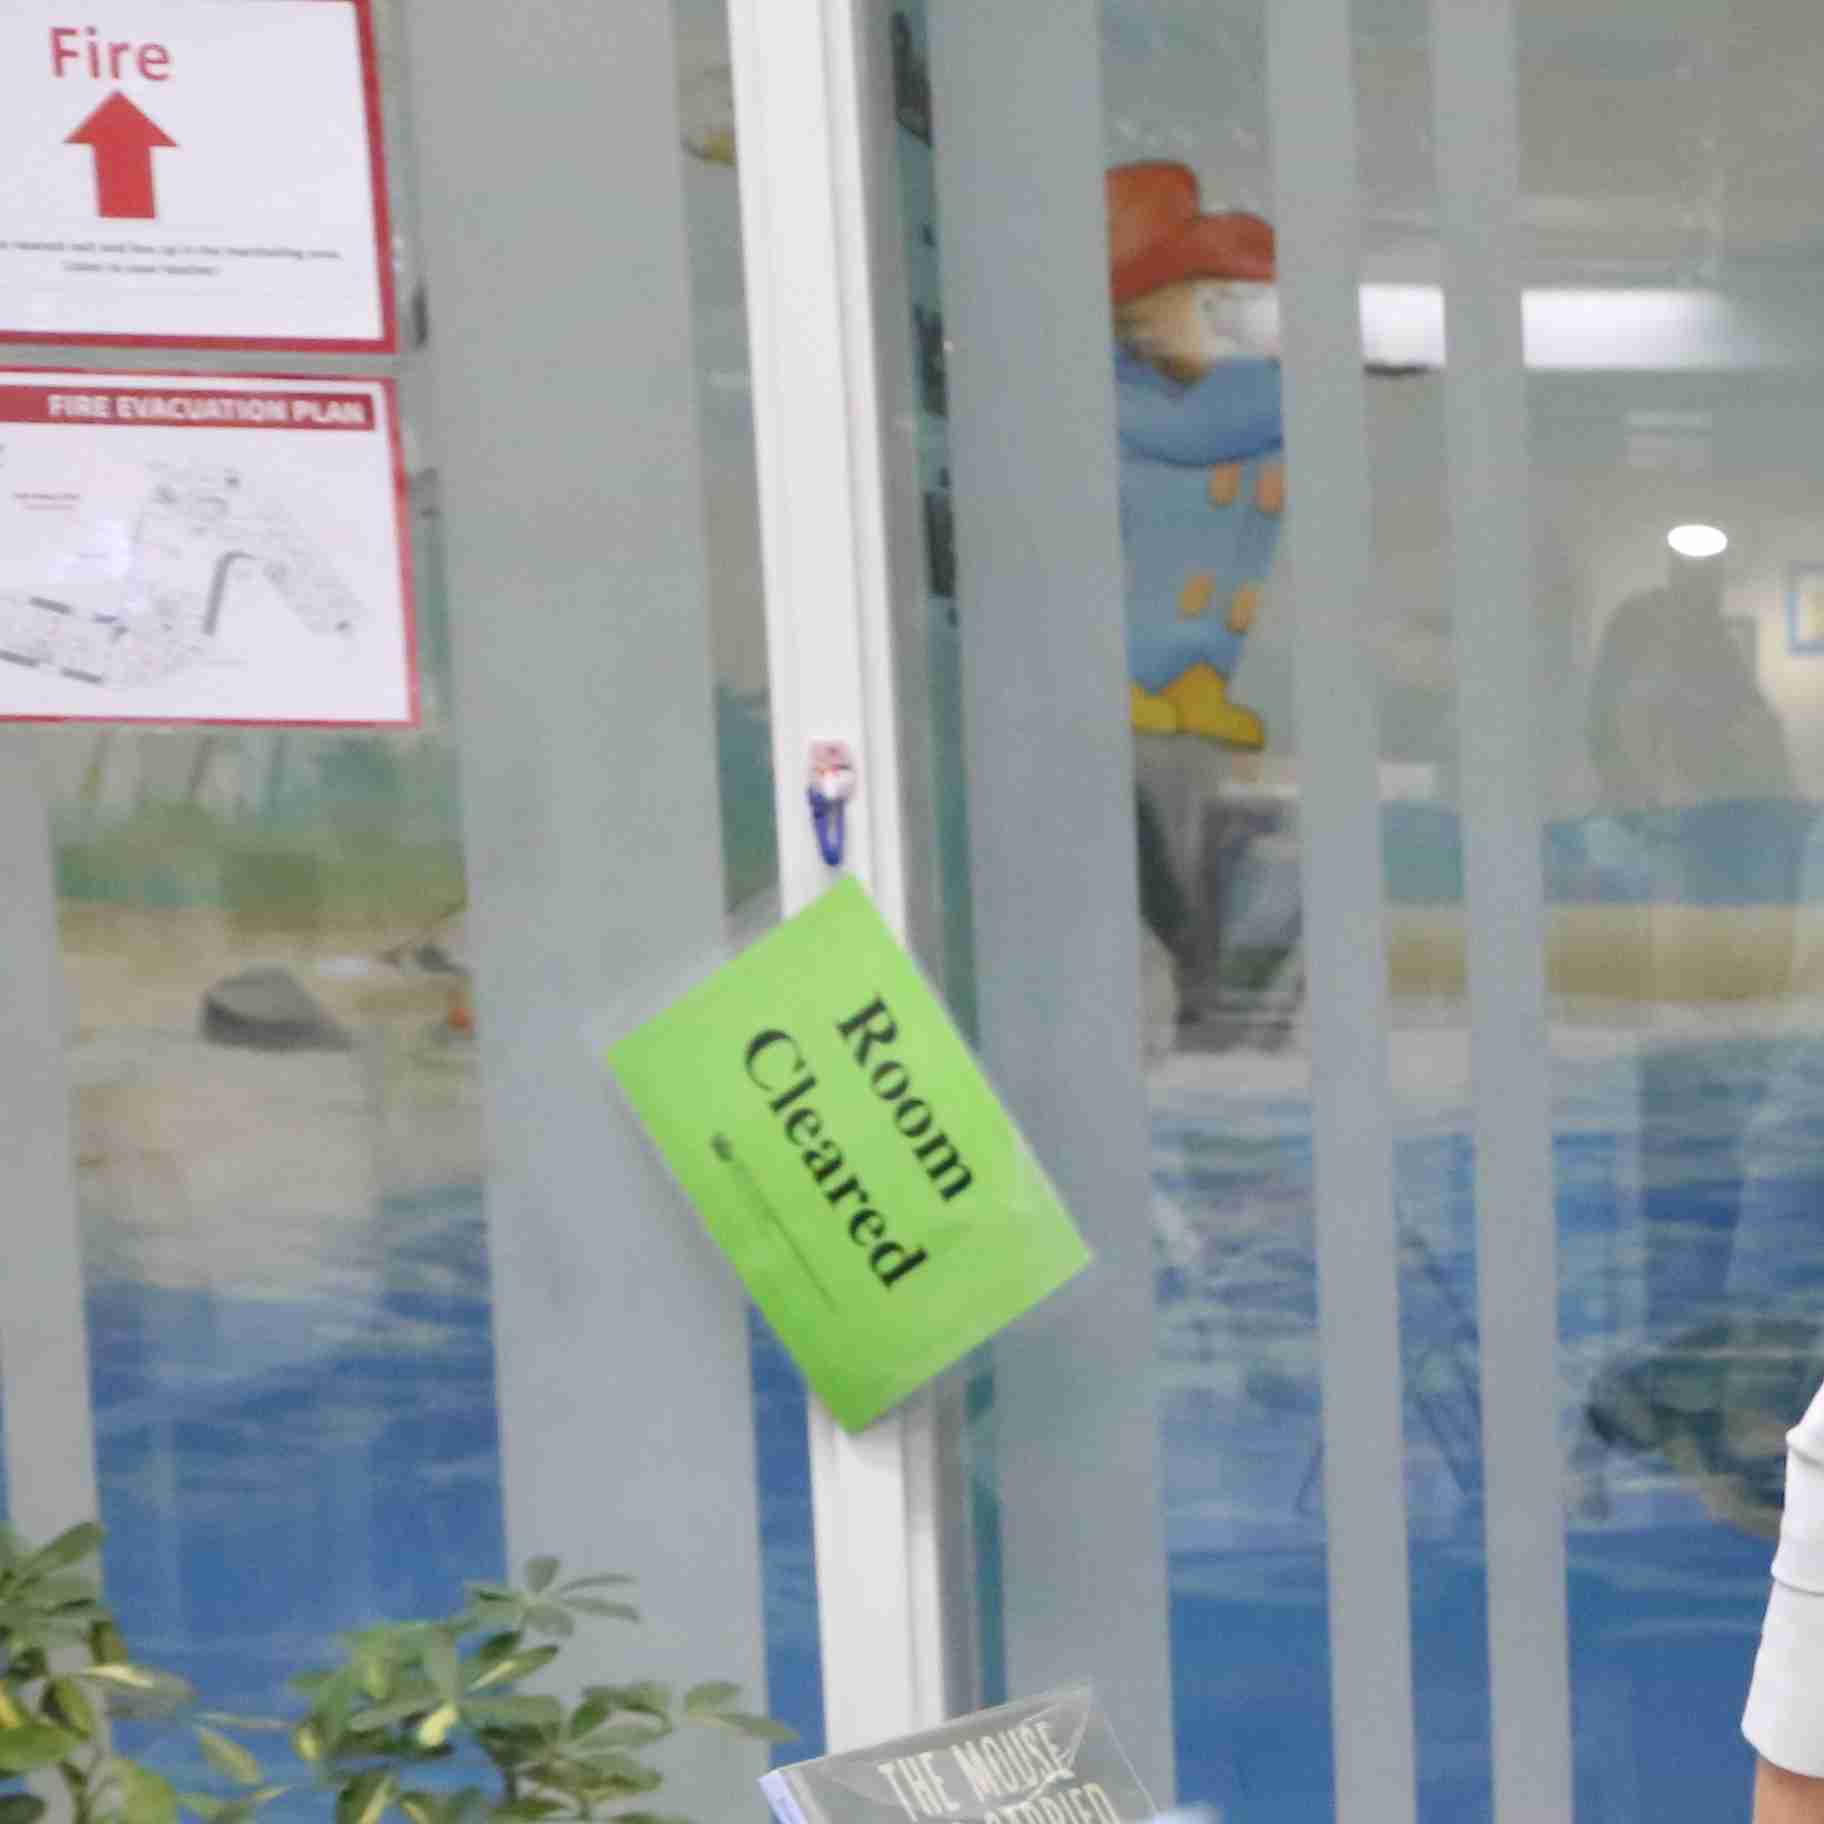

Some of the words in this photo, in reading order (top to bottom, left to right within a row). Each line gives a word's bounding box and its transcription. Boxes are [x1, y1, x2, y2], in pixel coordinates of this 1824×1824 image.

[49, 26, 172, 82] Fire
[48, 394, 112, 418] FIRE
[115, 395, 290, 422] EVACUATION
[292, 400, 366, 424] PLAN
[836, 992, 974, 1202] Room
[743, 1027, 929, 1292] Cleared
[876, 1751, 961, 1823] THE
[950, 1720, 1068, 1804] MOUSE
